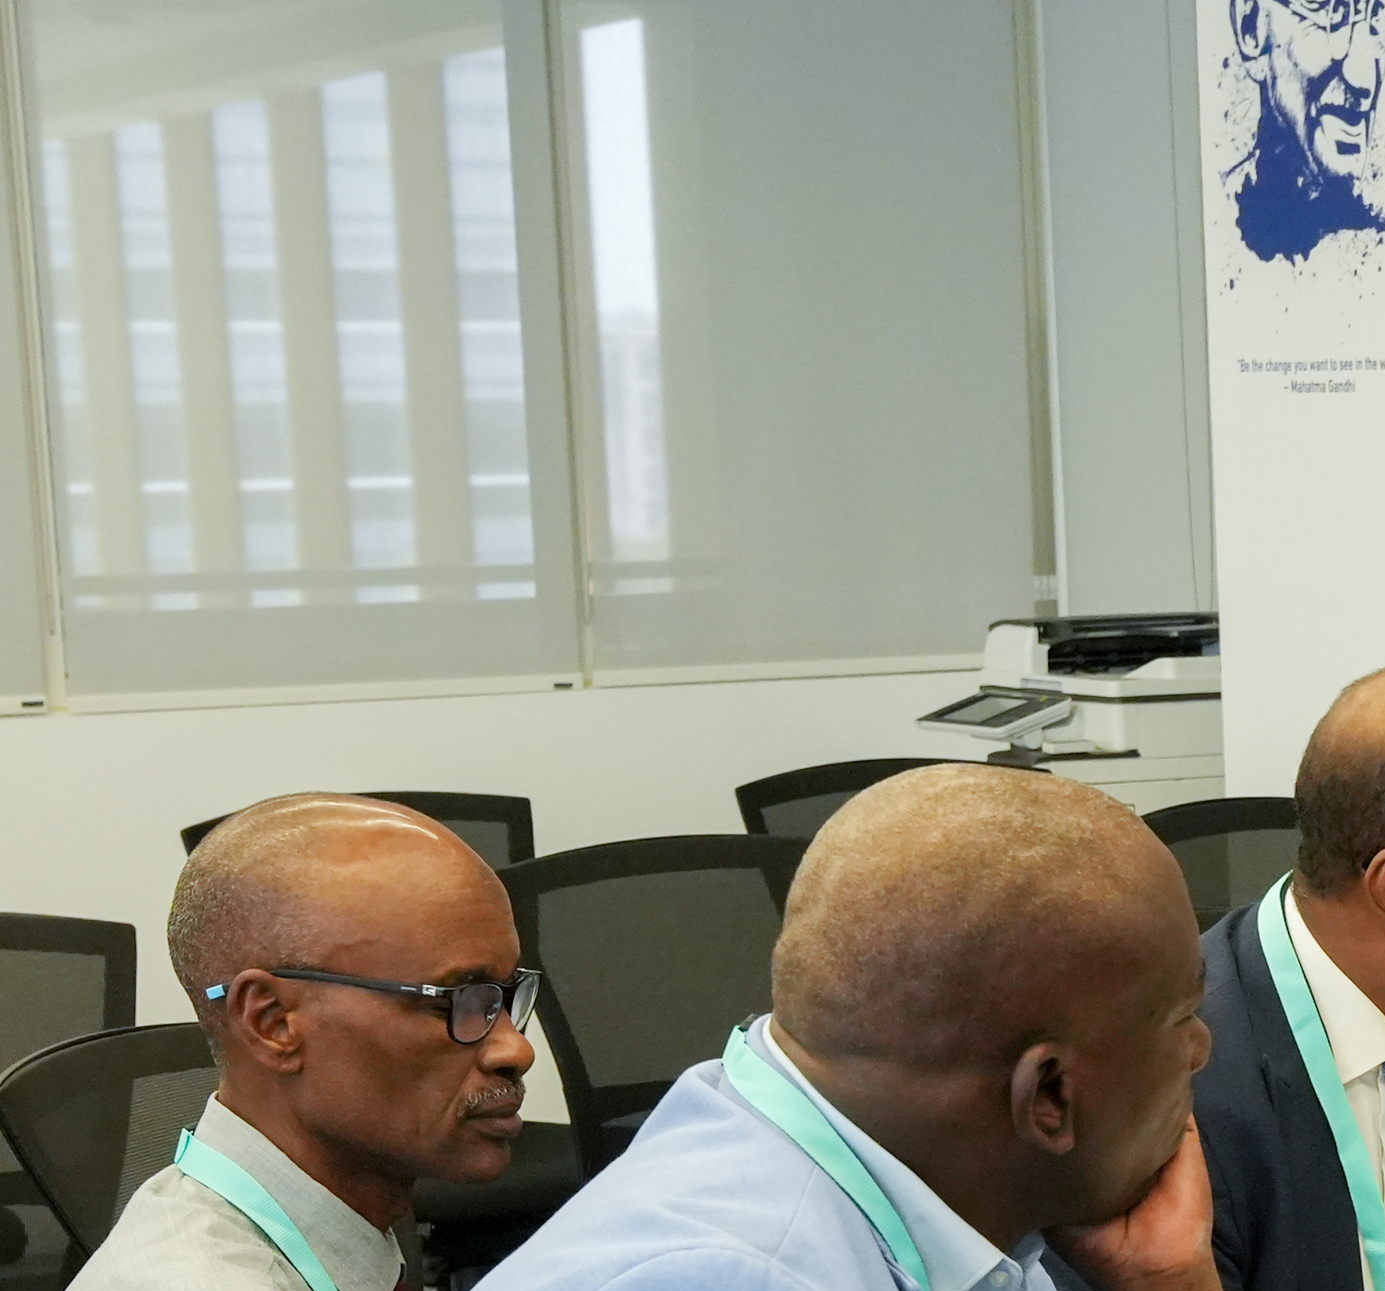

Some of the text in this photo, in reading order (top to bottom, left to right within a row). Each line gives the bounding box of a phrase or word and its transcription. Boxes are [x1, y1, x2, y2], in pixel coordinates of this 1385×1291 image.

[1252, 359, 1264, 372] the
[1265, 360, 1292, 375] change
[1294, 360, 1308, 375] you
[1309, 359, 1328, 372] want
[1329, 358, 1338, 371] to
[1339, 359, 1354, 371] see
[1355, 356, 1363, 371] in
[1364, 357, 1378, 371] the
[1290, 380, 1327, 393] Mahatma
[1328, 379, 1357, 393] Gandhi
